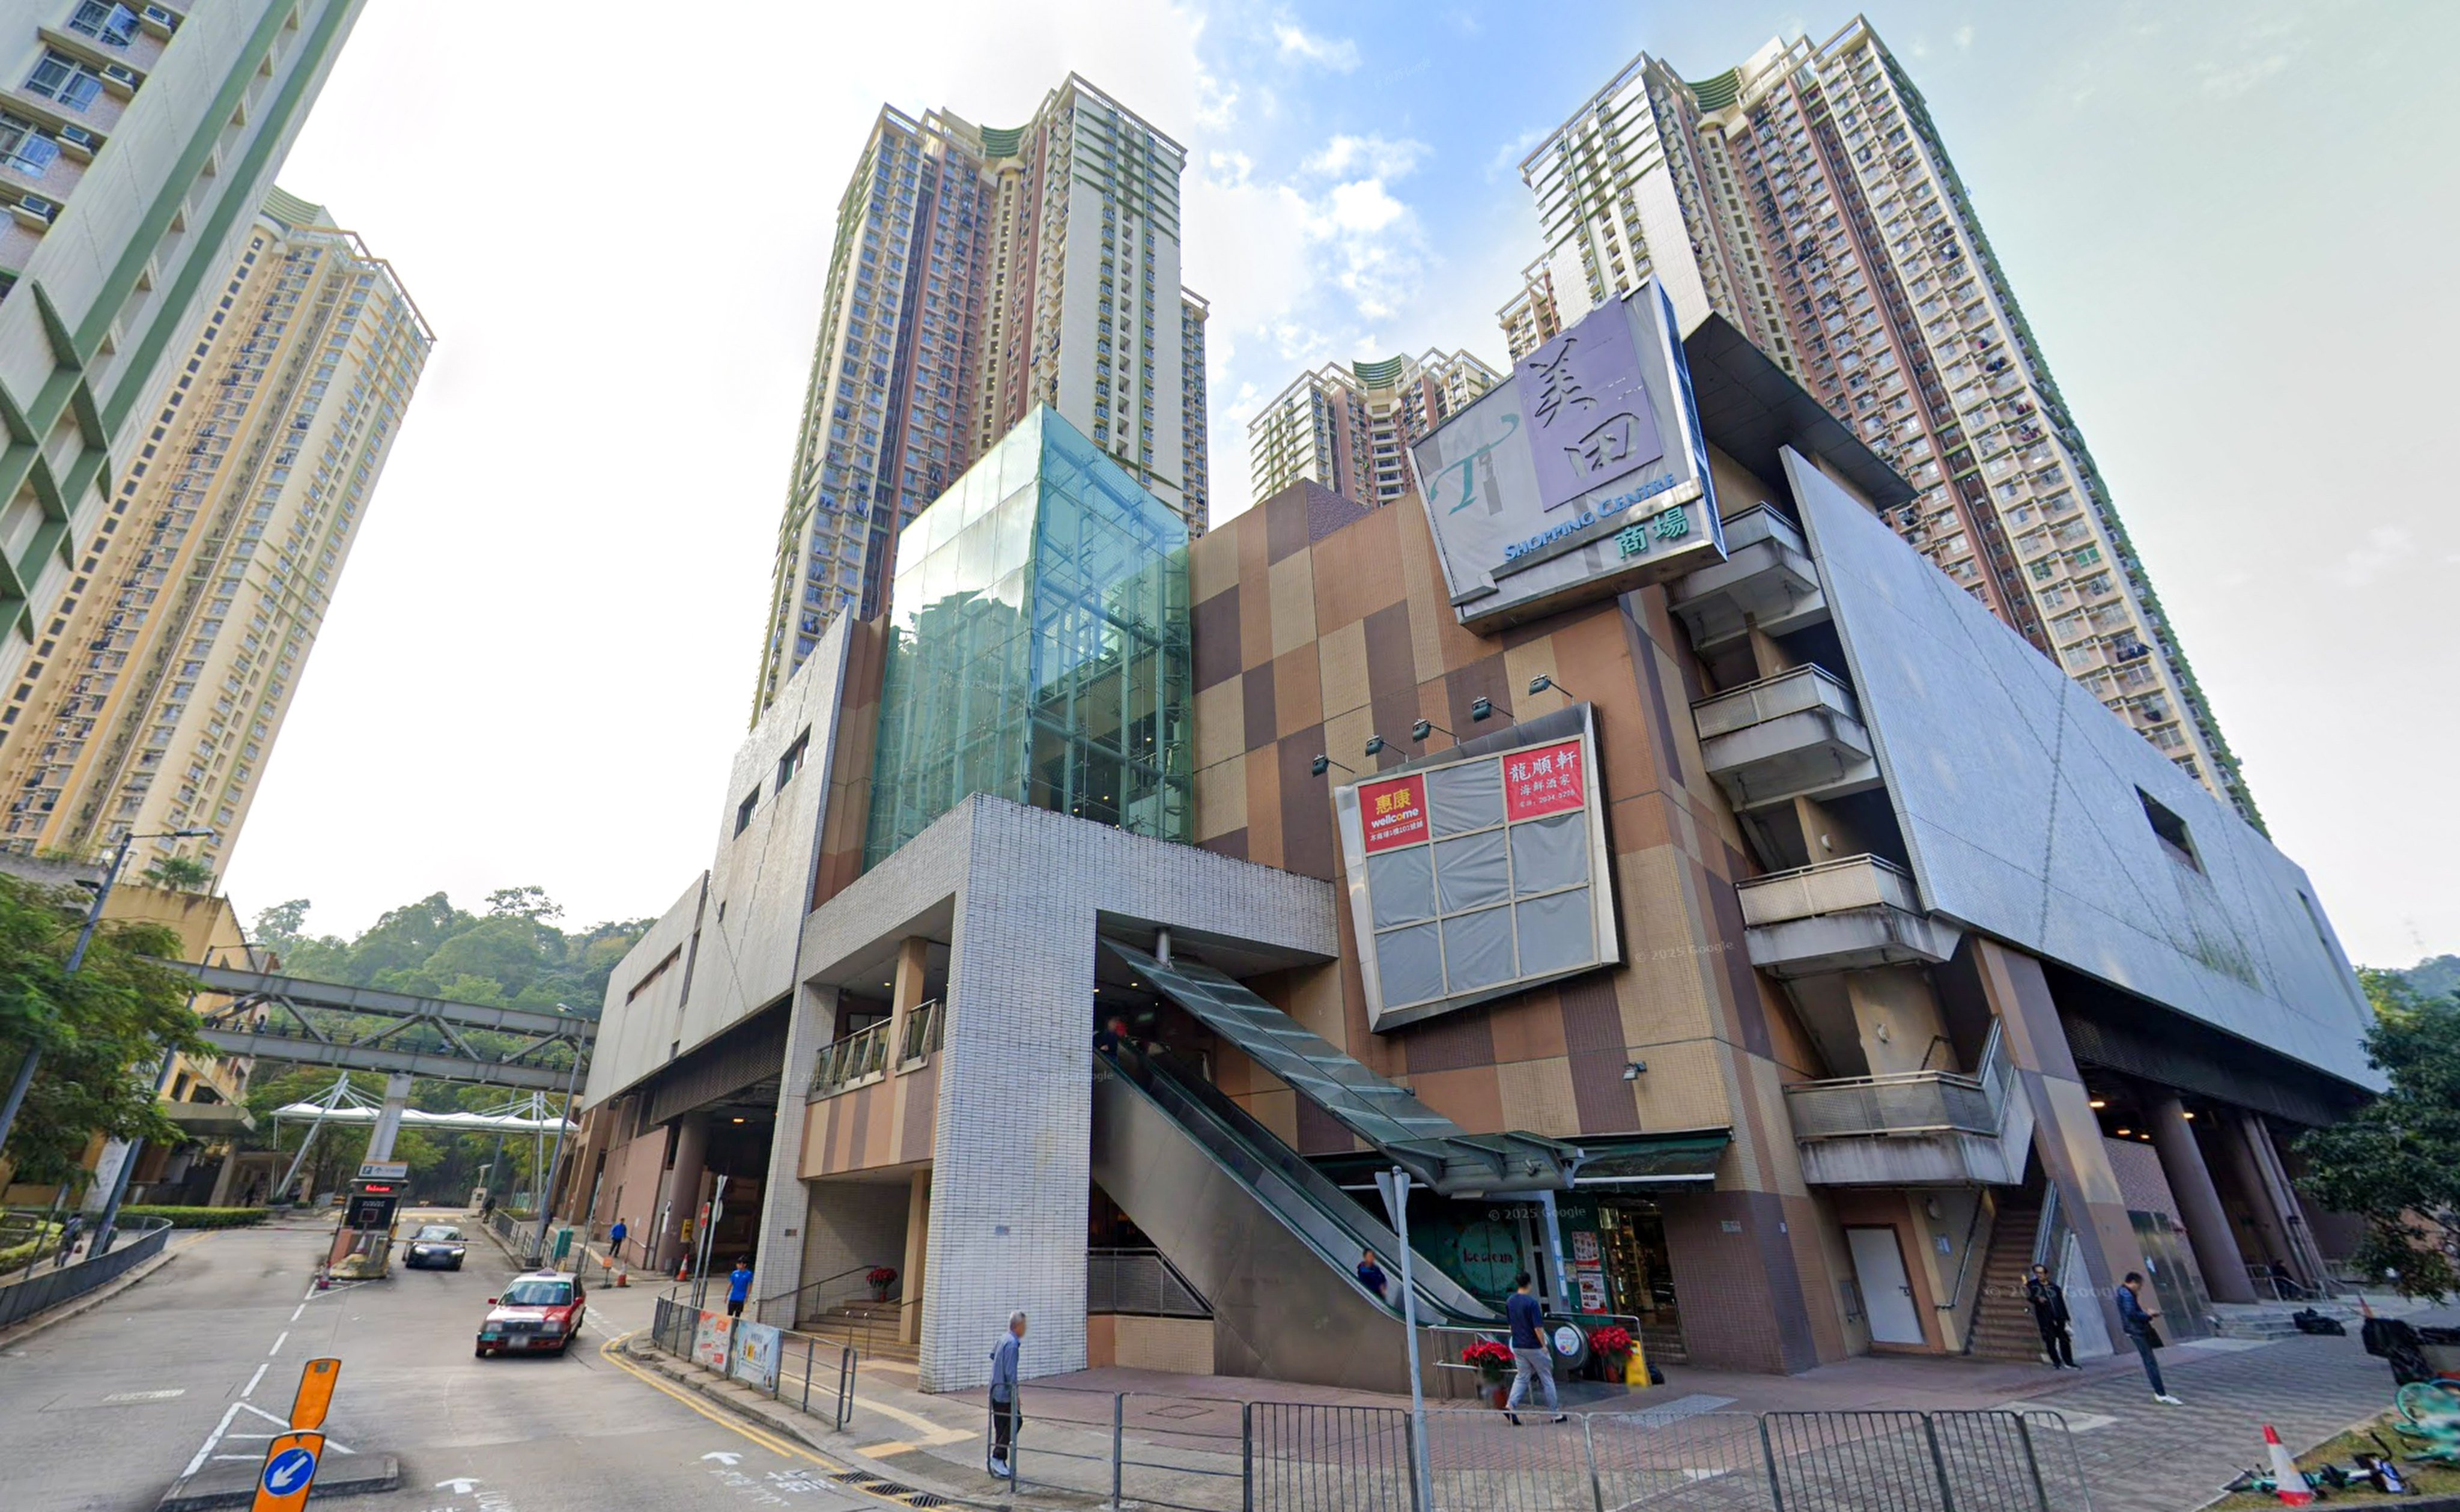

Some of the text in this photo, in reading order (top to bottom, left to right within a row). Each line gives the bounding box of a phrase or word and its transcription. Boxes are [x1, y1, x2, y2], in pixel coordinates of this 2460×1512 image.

[1503, 473, 1677, 562] SHOPPING CENTRE
[1614, 508, 1689, 561] 商場
[1509, 750, 1577, 783] 龍順軒
[1371, 807, 1420, 829] wellcome
[1374, 788, 1412, 815] 惠康
